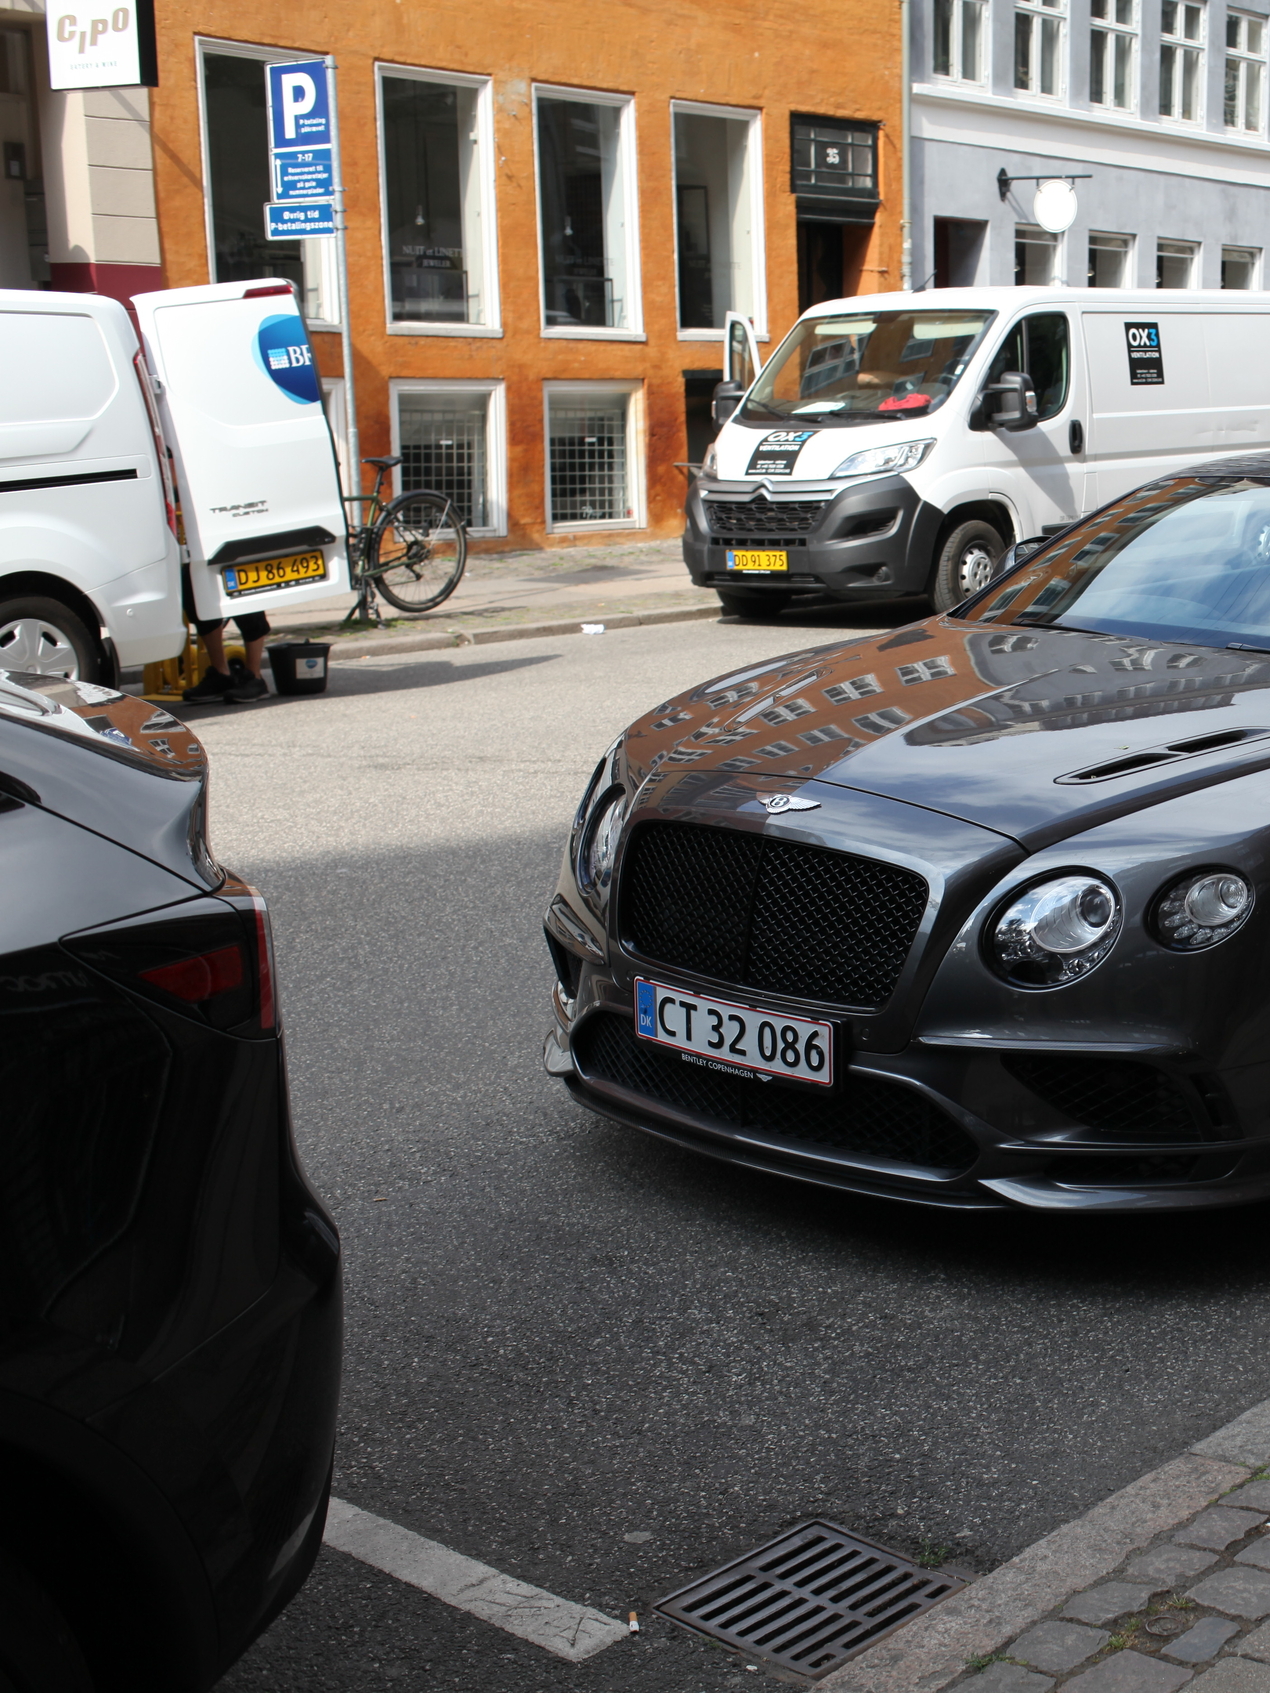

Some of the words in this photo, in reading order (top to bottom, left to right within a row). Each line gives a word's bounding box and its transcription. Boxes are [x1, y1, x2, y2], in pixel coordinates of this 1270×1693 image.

[57, 7, 129, 54] CIPO
[282, 72, 316, 139] P
[297, 152, 313, 162] 7-17
[826, 148, 840, 164] 35
[283, 211, 305, 220] Øvrig
[307, 210, 319, 218] tid
[270, 221, 333, 231] P-betalingszone
[1128, 328, 1158, 346] OX3
[767, 432, 815, 442] OX3
[210, 500, 267, 513] TRANSIT
[232, 508, 268, 517] CUSTOM
[734, 555, 748, 566] DD
[750, 555, 762, 566] 91
[766, 555, 784, 566] 375
[237, 566, 260, 586] DJ
[264, 560, 286, 581] 86
[290, 555, 320, 575] 493
[640, 1014, 652, 1028] DK
[658, 995, 698, 1042] CT
[707, 1008, 747, 1057] 32
[758, 1020, 825, 1072] 086
[681, 1053, 706, 1067] BENTLEY
[708, 1061, 754, 1079] COPENHAGEN
